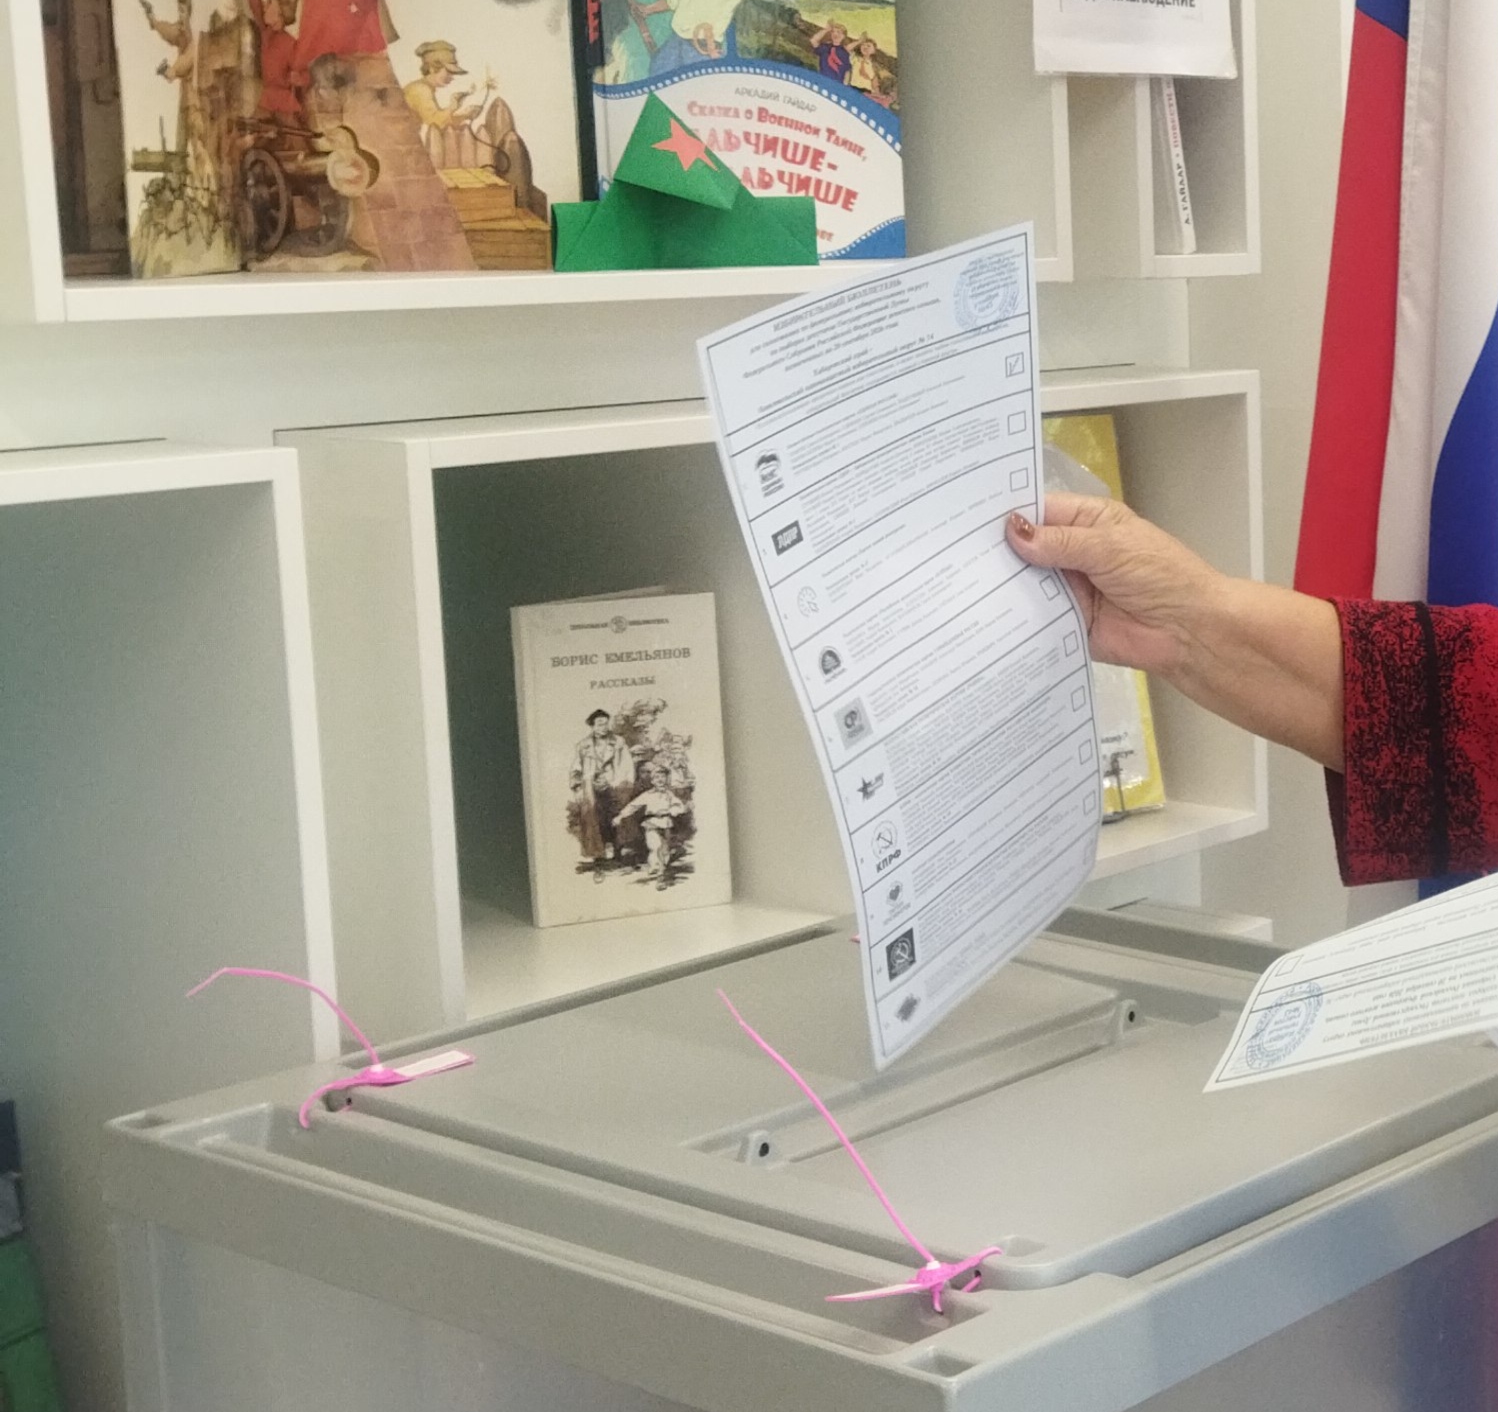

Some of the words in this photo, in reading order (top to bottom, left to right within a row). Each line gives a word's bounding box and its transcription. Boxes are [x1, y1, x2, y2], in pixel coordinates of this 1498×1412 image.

[734, 86, 781, 105] АРКАДИЙ
[783, 93, 817, 114] ГАЙДАР
[551, 653, 598, 668] БОРИС
[604, 647, 691, 664] ЕМЕЛЬЯНОВ
[589, 675, 656, 690] РАССКАЗЫ
[875, 848, 902, 874] КПРФ
